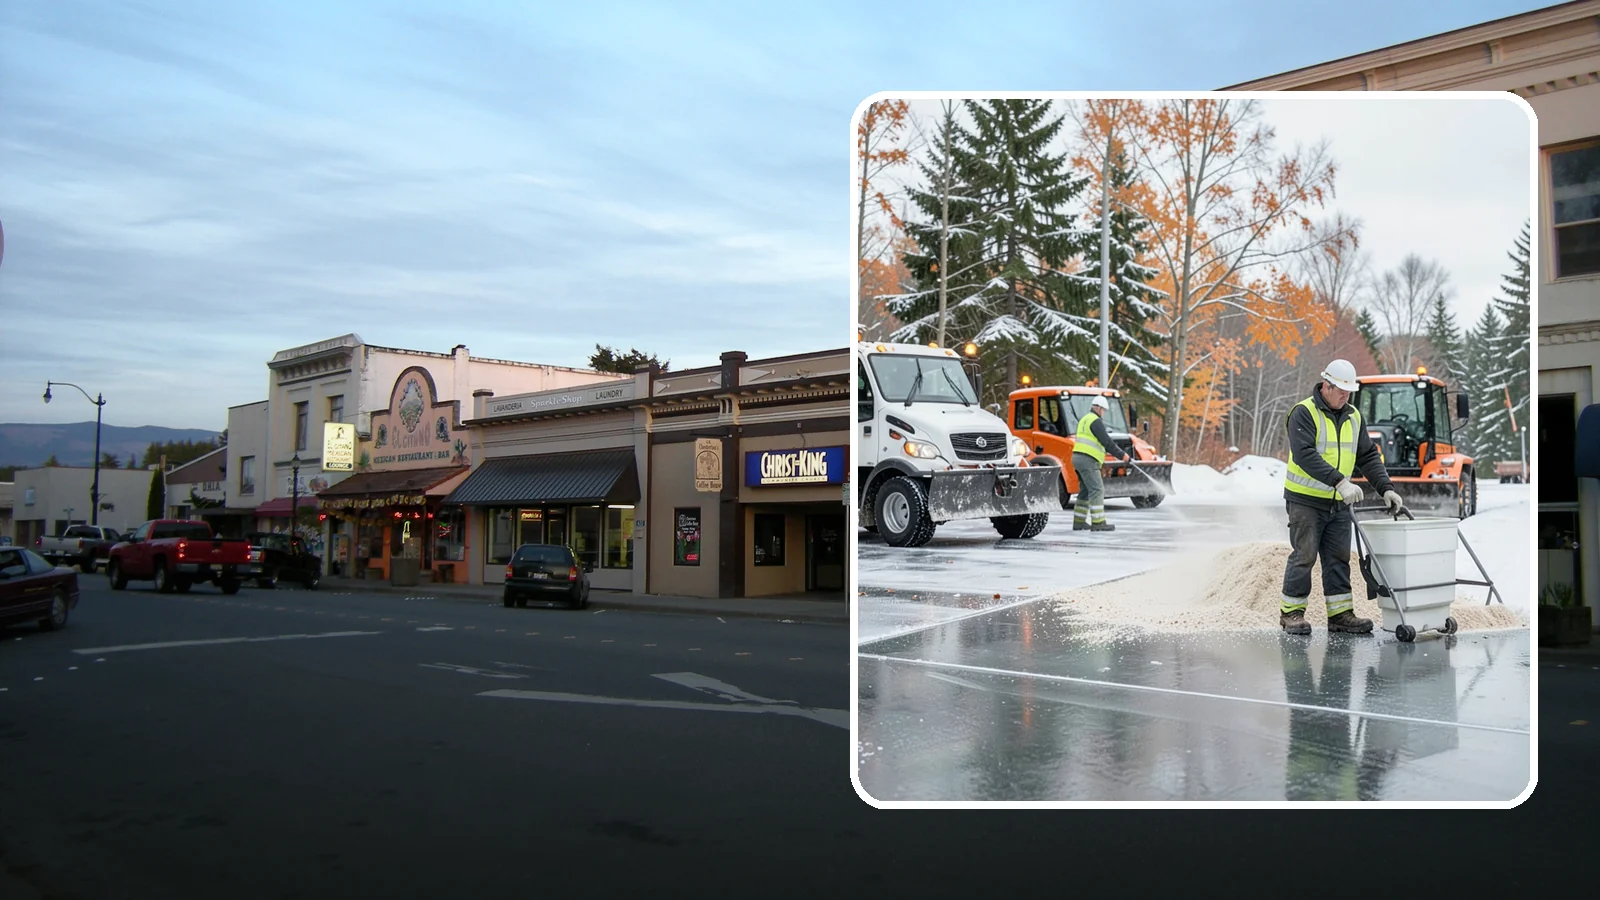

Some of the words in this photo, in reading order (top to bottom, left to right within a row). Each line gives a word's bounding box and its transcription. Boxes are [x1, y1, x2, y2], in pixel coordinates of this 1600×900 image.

[494, 402, 523, 412] LAVANDERIA
[531, 398, 561, 409] Sparkle
[562, 394, 582, 405] Shop
[595, 389, 624, 400] LAUNDRY
[397, 450, 434, 462] RESTAURANT
[437, 450, 450, 459] BAR
[761, 452, 797, 478] CHRIST
[799, 450, 827, 476] KING
[696, 480, 709, 489] Coffee
